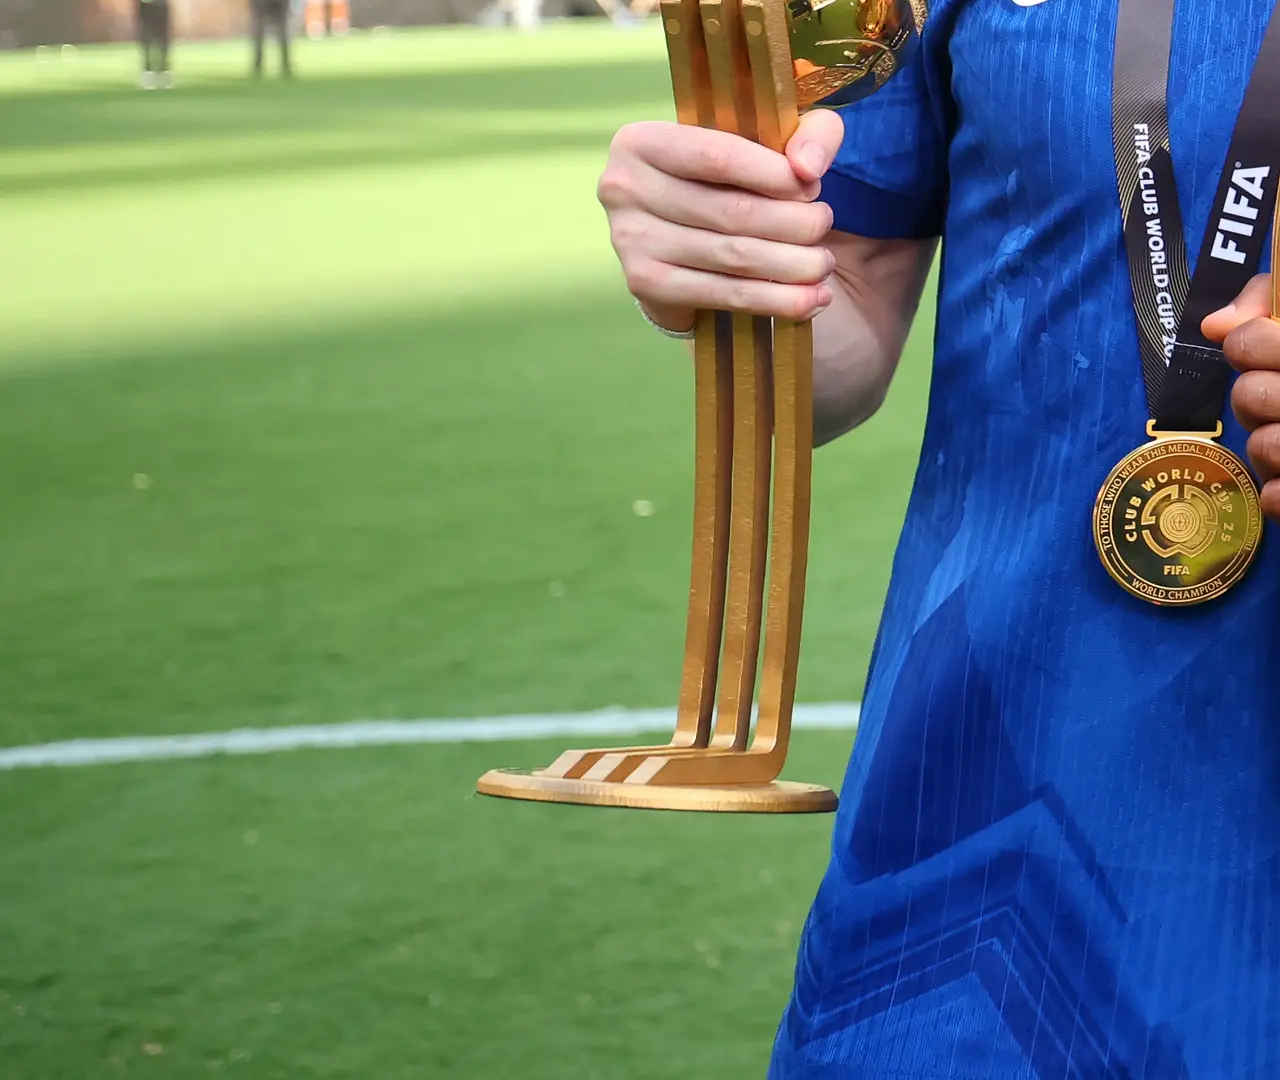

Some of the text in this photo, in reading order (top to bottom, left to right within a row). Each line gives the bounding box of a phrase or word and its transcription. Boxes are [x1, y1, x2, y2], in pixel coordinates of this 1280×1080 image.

[1134, 123, 1150, 163] FIFA
[1138, 167, 1159, 216] CLUB
[1210, 165, 1270, 264] FIFA
[1146, 218, 1169, 287] WORLD
[1155, 289, 1176, 333] CUP
[1143, 446, 1167, 460] THIS
[1205, 448, 1240, 474] HISTORY
[1119, 457, 1144, 479] WEAR
[1105, 478, 1122, 502] WHO
[1100, 502, 1111, 534] THOSE
[1124, 468, 1234, 542] CLUB WORLD CUP 25
[1103, 535, 1112, 551] TO
[1163, 565, 1191, 576] FIFA
[1131, 578, 1223, 600] WORLD CHAMPION
